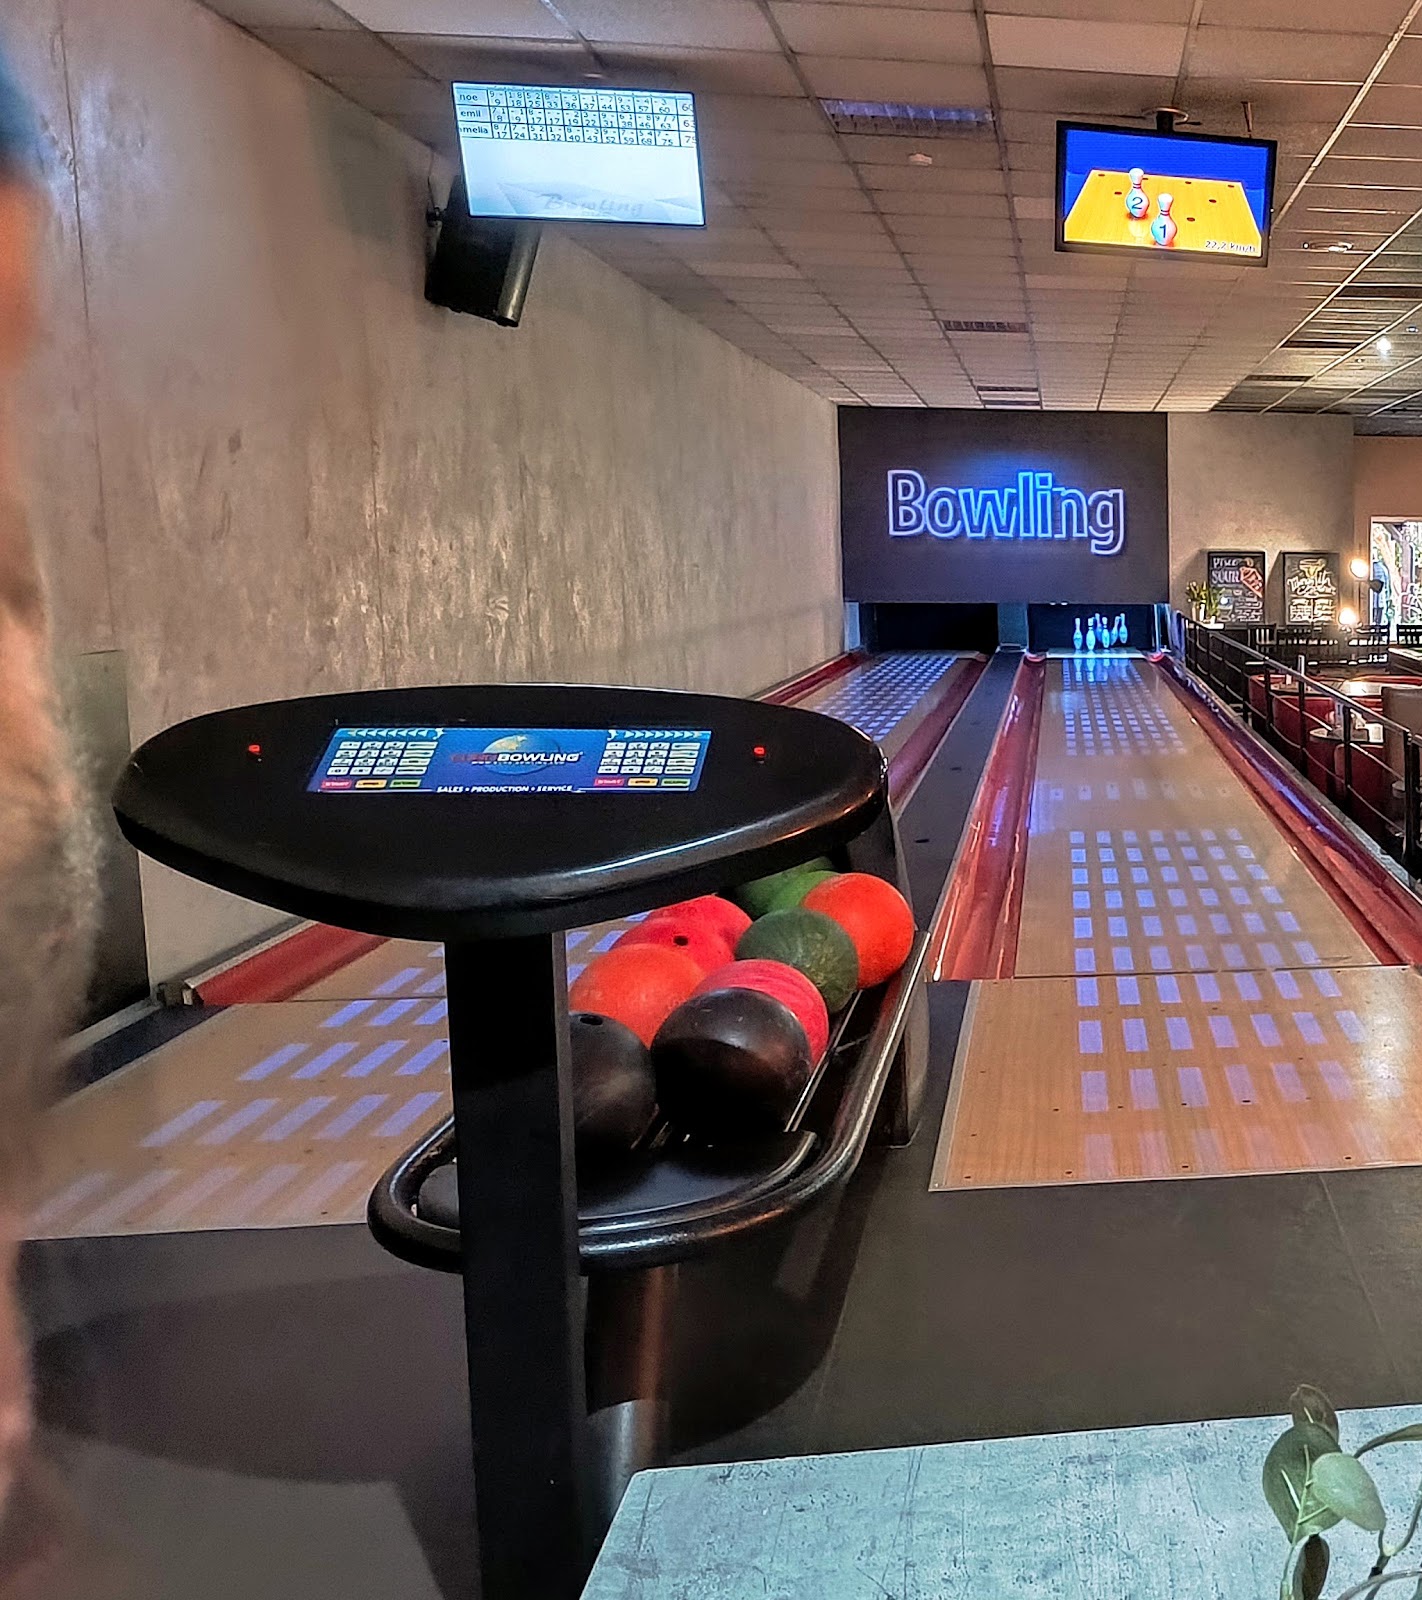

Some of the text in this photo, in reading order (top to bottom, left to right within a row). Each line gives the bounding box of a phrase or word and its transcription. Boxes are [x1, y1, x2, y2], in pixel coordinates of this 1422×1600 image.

[1132, 197, 1143, 210] 2
[1159, 224, 1167, 238] 1
[887, 469, 1124, 555] Bowling
